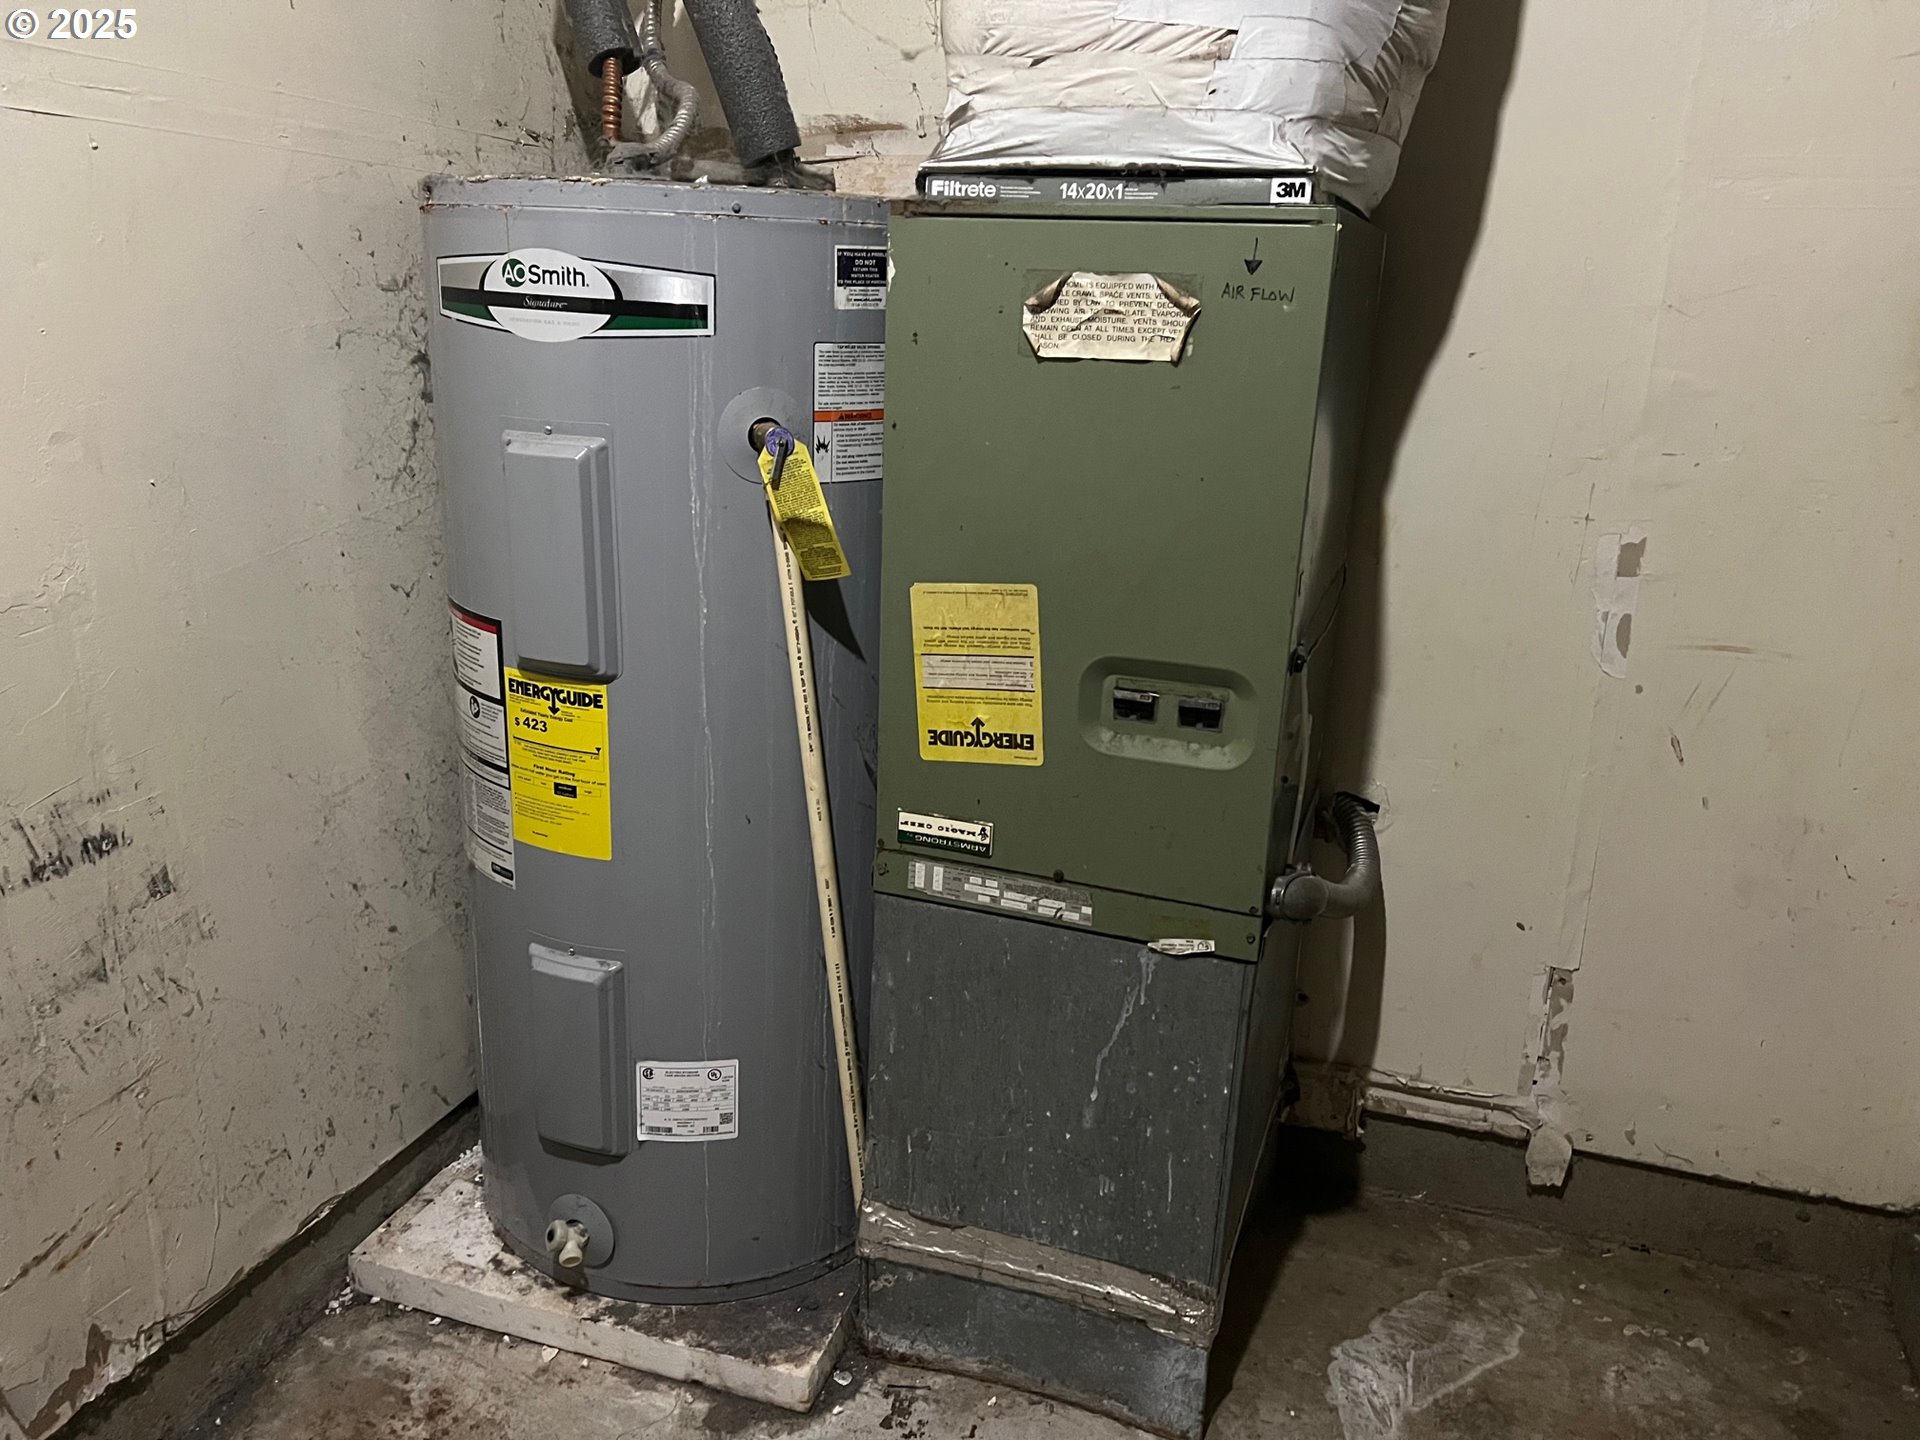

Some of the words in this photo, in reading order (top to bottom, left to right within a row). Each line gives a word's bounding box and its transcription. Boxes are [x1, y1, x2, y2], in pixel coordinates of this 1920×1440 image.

[931, 179, 996, 197] Filtrete
[1059, 182, 1123, 199] 14x20x1
[1276, 182, 1306, 198] 3M
[1221, 282, 1246, 300] AIR
[1250, 287, 1295, 303] FLOW
[523, 296, 568, 309] Signature
[508, 678, 604, 711] ENERGYGUIDE
[514, 717, 520, 726] $
[523, 716, 548, 732] 423
[928, 729, 1034, 750] ENERGYGUIDE
[937, 826, 976, 836] MAGIC
[914, 834, 986, 852] ARMSTRONG
